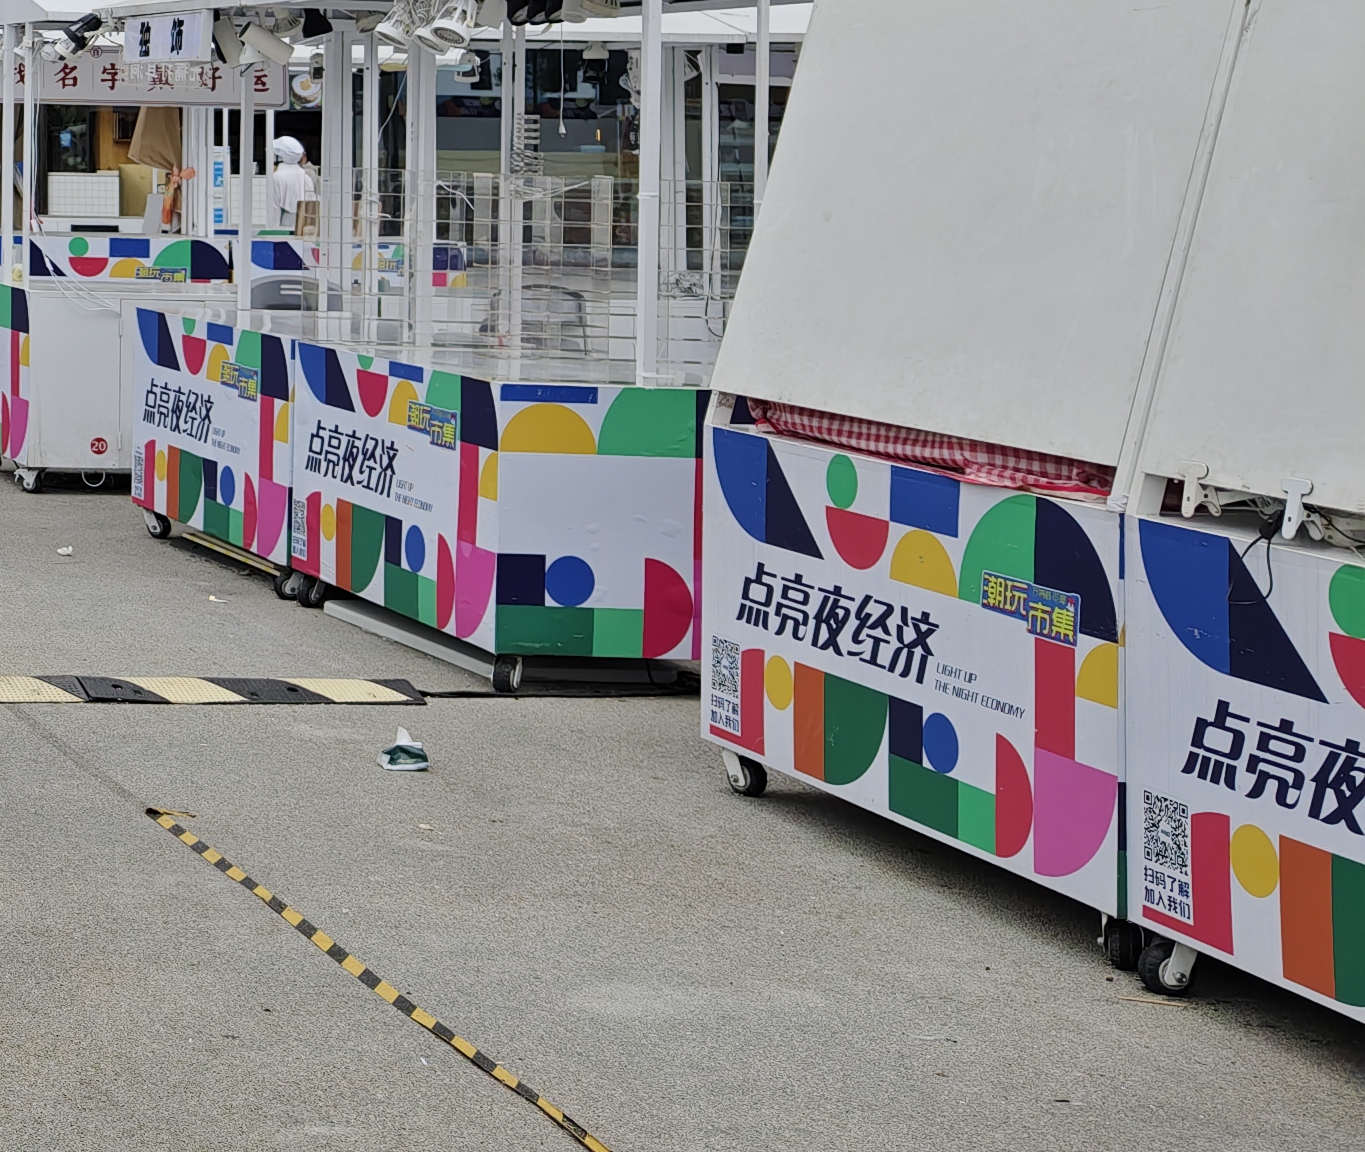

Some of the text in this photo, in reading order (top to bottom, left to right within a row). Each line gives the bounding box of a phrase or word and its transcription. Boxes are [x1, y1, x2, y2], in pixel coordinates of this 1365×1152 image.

[142, 377, 215, 444] 点亮夜经济
[408, 401, 457, 449] 潮玩市集
[91, 439, 107, 454] 20
[305, 419, 399, 499] 点亮夜经济
[736, 562, 940, 685] 点亮夜经济
[982, 574, 1074, 643] 潮玩市集
[936, 662, 977, 684] LIGHT UP
[711, 693, 739, 716] 扫码了解
[934, 678, 1026, 719] THE NIGHT ECONOMY
[710, 709, 740, 733] 加入我们
[1143, 866, 1191, 901] 扫码了解
[1143, 886, 1192, 921] 加入我们
